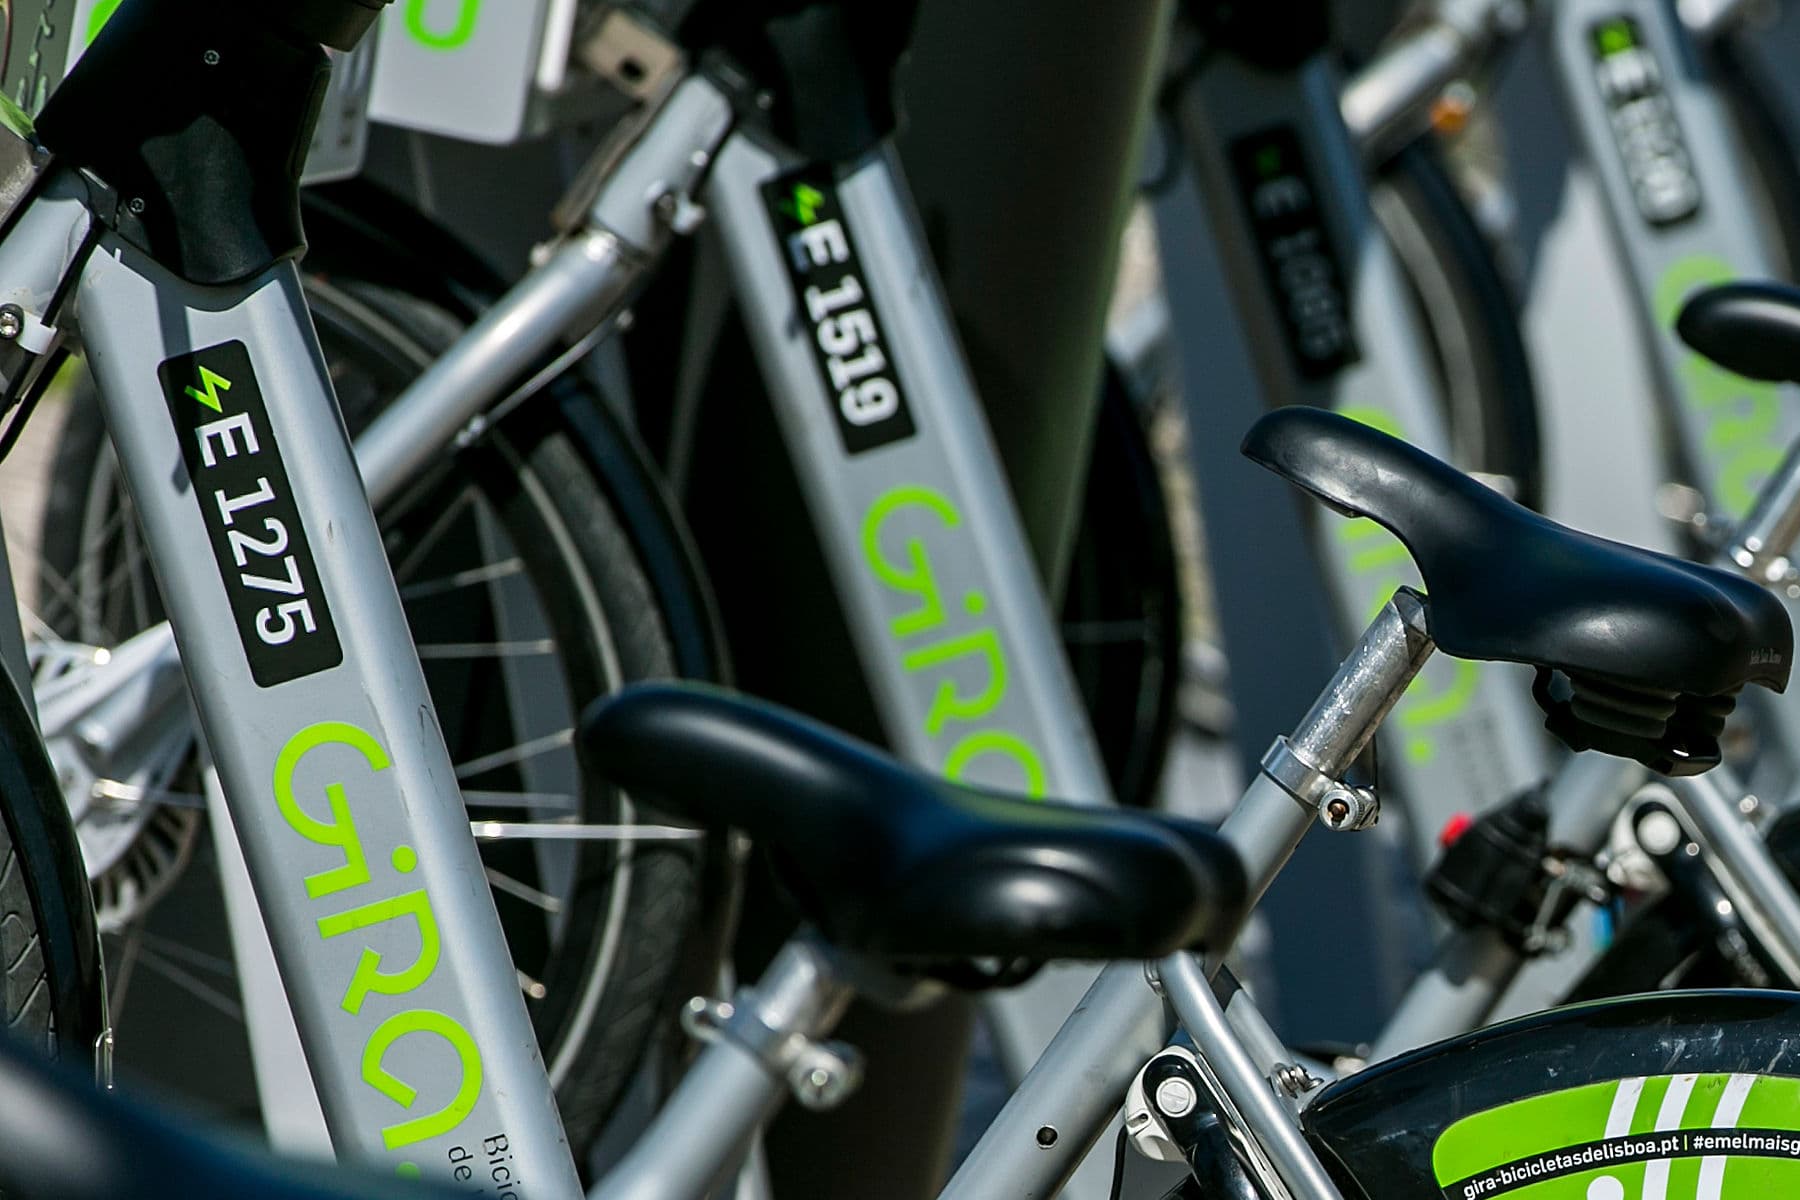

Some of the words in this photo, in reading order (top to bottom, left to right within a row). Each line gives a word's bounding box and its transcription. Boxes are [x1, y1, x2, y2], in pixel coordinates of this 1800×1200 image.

[787, 219, 849, 272] E
[804, 274, 899, 426] 1519
[194, 411, 260, 468] E
[214, 477, 317, 646] 1275
[448, 1146, 474, 1182] de
